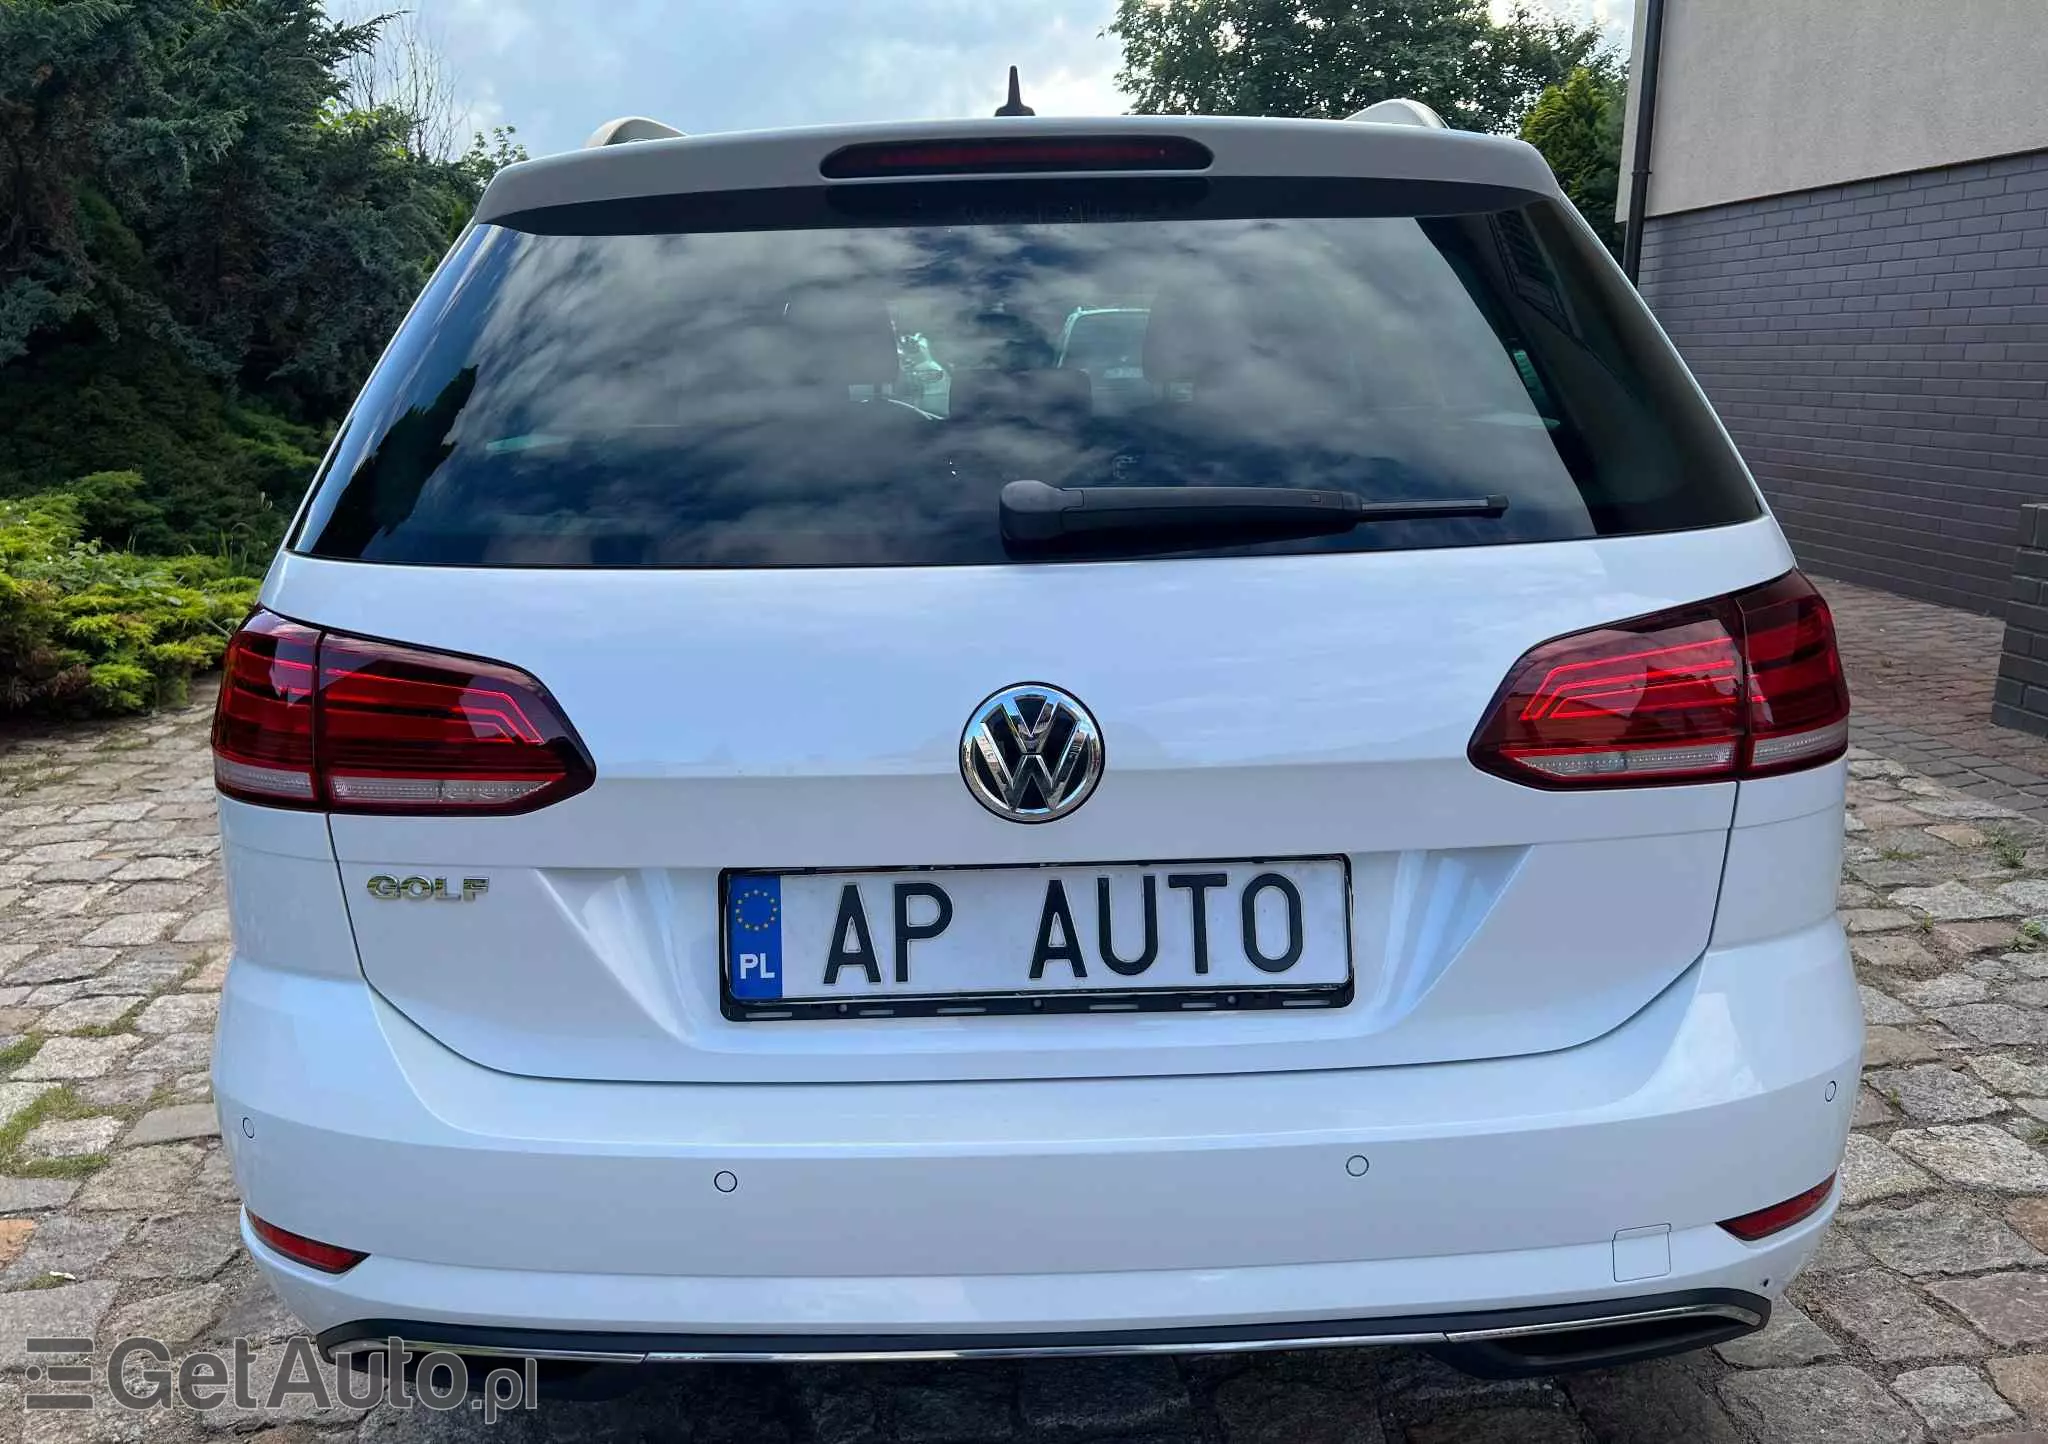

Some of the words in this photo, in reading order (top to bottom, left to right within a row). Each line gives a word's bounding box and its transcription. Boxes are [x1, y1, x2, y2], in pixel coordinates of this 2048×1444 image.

[366, 873, 490, 901] GOLF
[823, 882, 954, 985] AP
[1028, 872, 1303, 980] AUTO
[738, 951, 776, 980] PL
